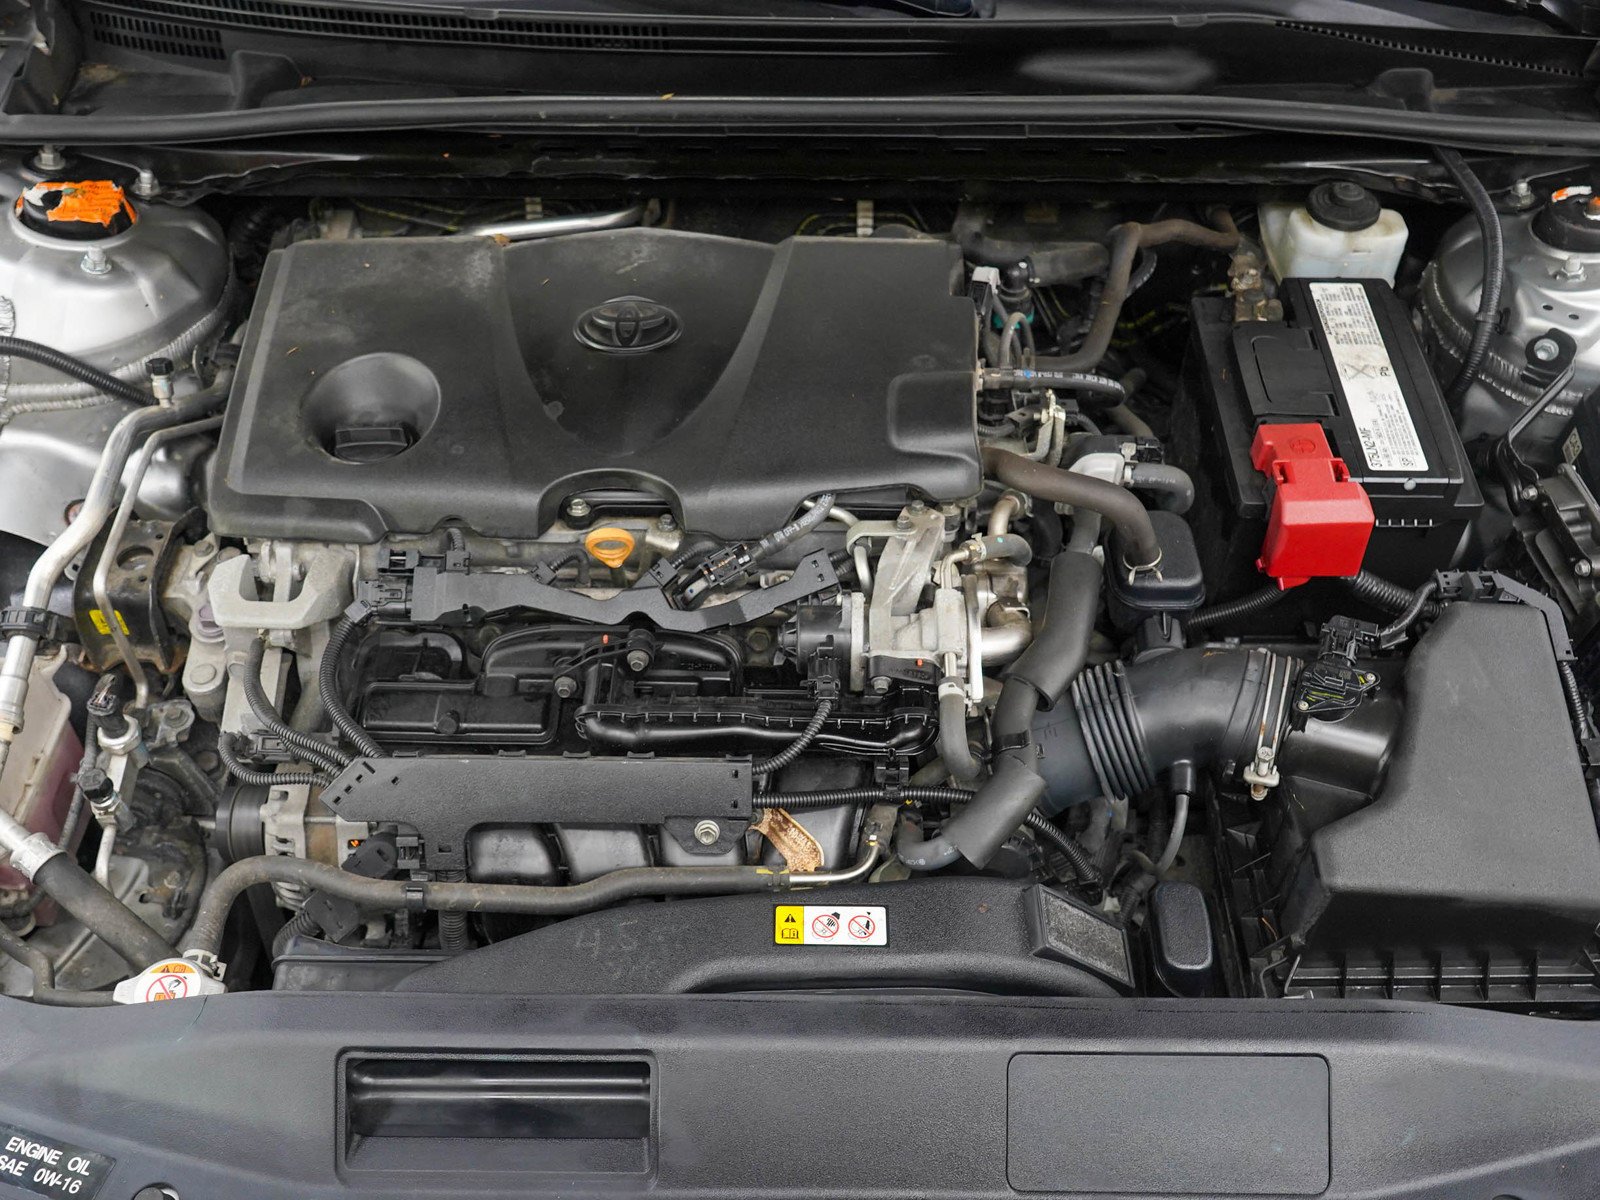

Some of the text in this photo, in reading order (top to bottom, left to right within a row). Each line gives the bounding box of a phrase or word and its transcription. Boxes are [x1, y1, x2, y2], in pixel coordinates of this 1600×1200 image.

[1379, 366, 1391, 377] Pb
[0, 1155, 82, 1194] SAE 0W-16
[5, 1136, 91, 1176] ENGINE OIL
